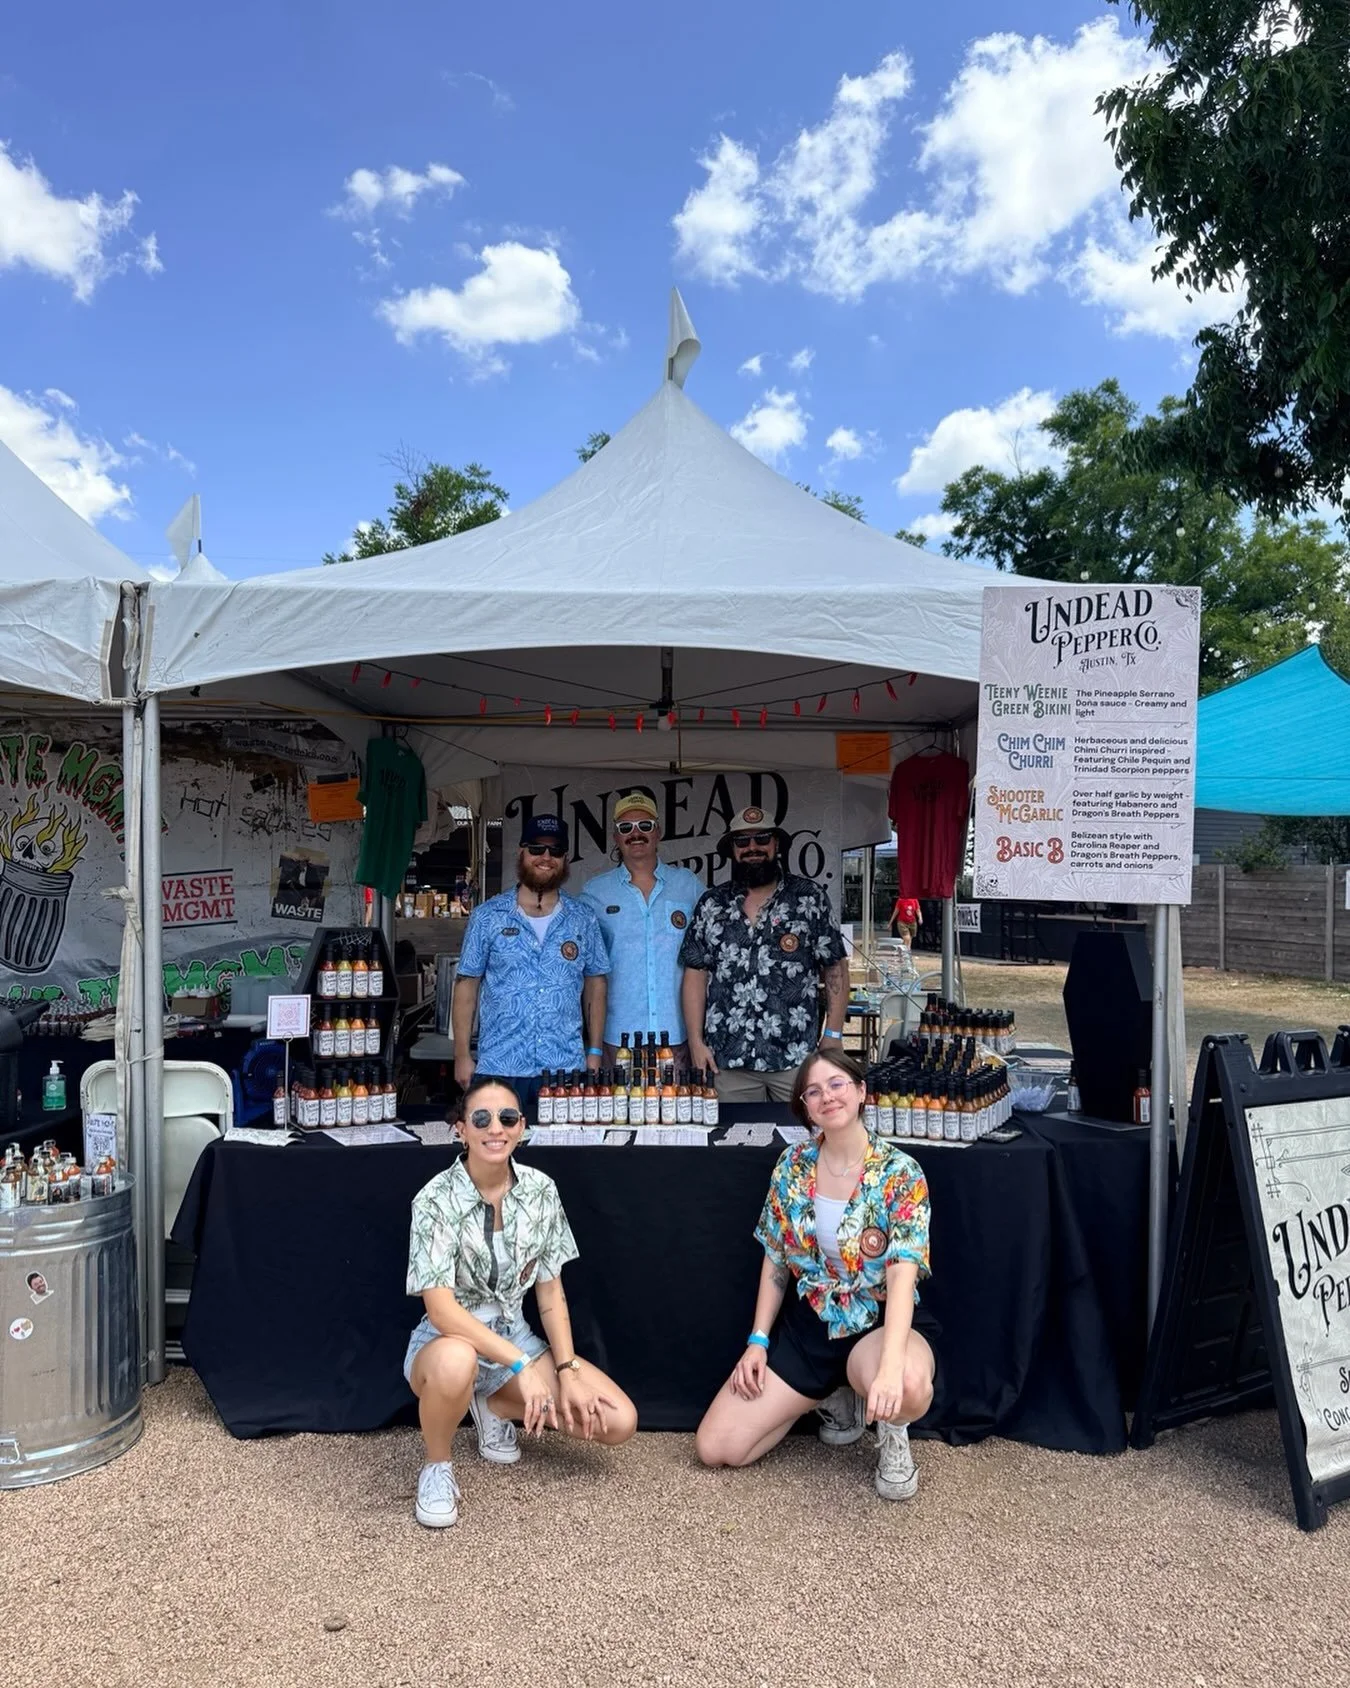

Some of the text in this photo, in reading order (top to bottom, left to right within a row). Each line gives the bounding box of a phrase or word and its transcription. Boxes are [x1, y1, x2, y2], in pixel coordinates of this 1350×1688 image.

[1024, 589, 1153, 644] UNDEAD
[1051, 627, 1132, 669] PEPPER
[984, 683, 1068, 701] TEENY WEENIE
[1076, 690, 1175, 699] The Pineapple Serrano
[992, 700, 1071, 718] GREEN BIKINI
[1075, 708, 1095, 717] light
[1134, 700, 1168, 709] Creamy
[1170, 700, 1187, 708] and
[997, 733, 1066, 753] CHIM CHIM
[1074, 737, 1188, 745] Herbaceous and delicious
[1074, 746, 1098, 754] Chimi
[1100, 746, 1128, 754] Churri
[1129, 746, 1166, 756] inspired
[0, 735, 50, 789] TE
[1008, 751, 1054, 771] CHURRI
[1073, 756, 1191, 766] Featuring Chile Pequin and
[1073, 765, 1190, 776] Trinidad Scorpion peppers
[987, 785, 1045, 806] SHOOTER
[1095, 790, 1113, 798] half
[1114, 790, 1140, 800] garlic
[1142, 791, 1153, 800] by
[1154, 791, 1184, 801] weight
[1072, 800, 1178, 809] featuring Habanero and
[504, 771, 790, 864] NEAD
[1071, 809, 1180, 819] Dragon's Breath Peppers
[1109, 832, 1132, 841] style
[996, 836, 1065, 864] BASIC B
[1071, 841, 1160, 851] Carolina Reaper and
[1070, 851, 1108, 860] Dragon's
[1109, 852, 1139, 860] Breath
[1105, 861, 1123, 869] and
[1124, 862, 1154, 870] onions
[163, 898, 236, 922] MGMT
[274, 902, 323, 919] WASTE
[1272, 1199, 1350, 1300] UND
[1313, 1274, 1350, 1337] PE
[1339, 1366, 1350, 1394] S
